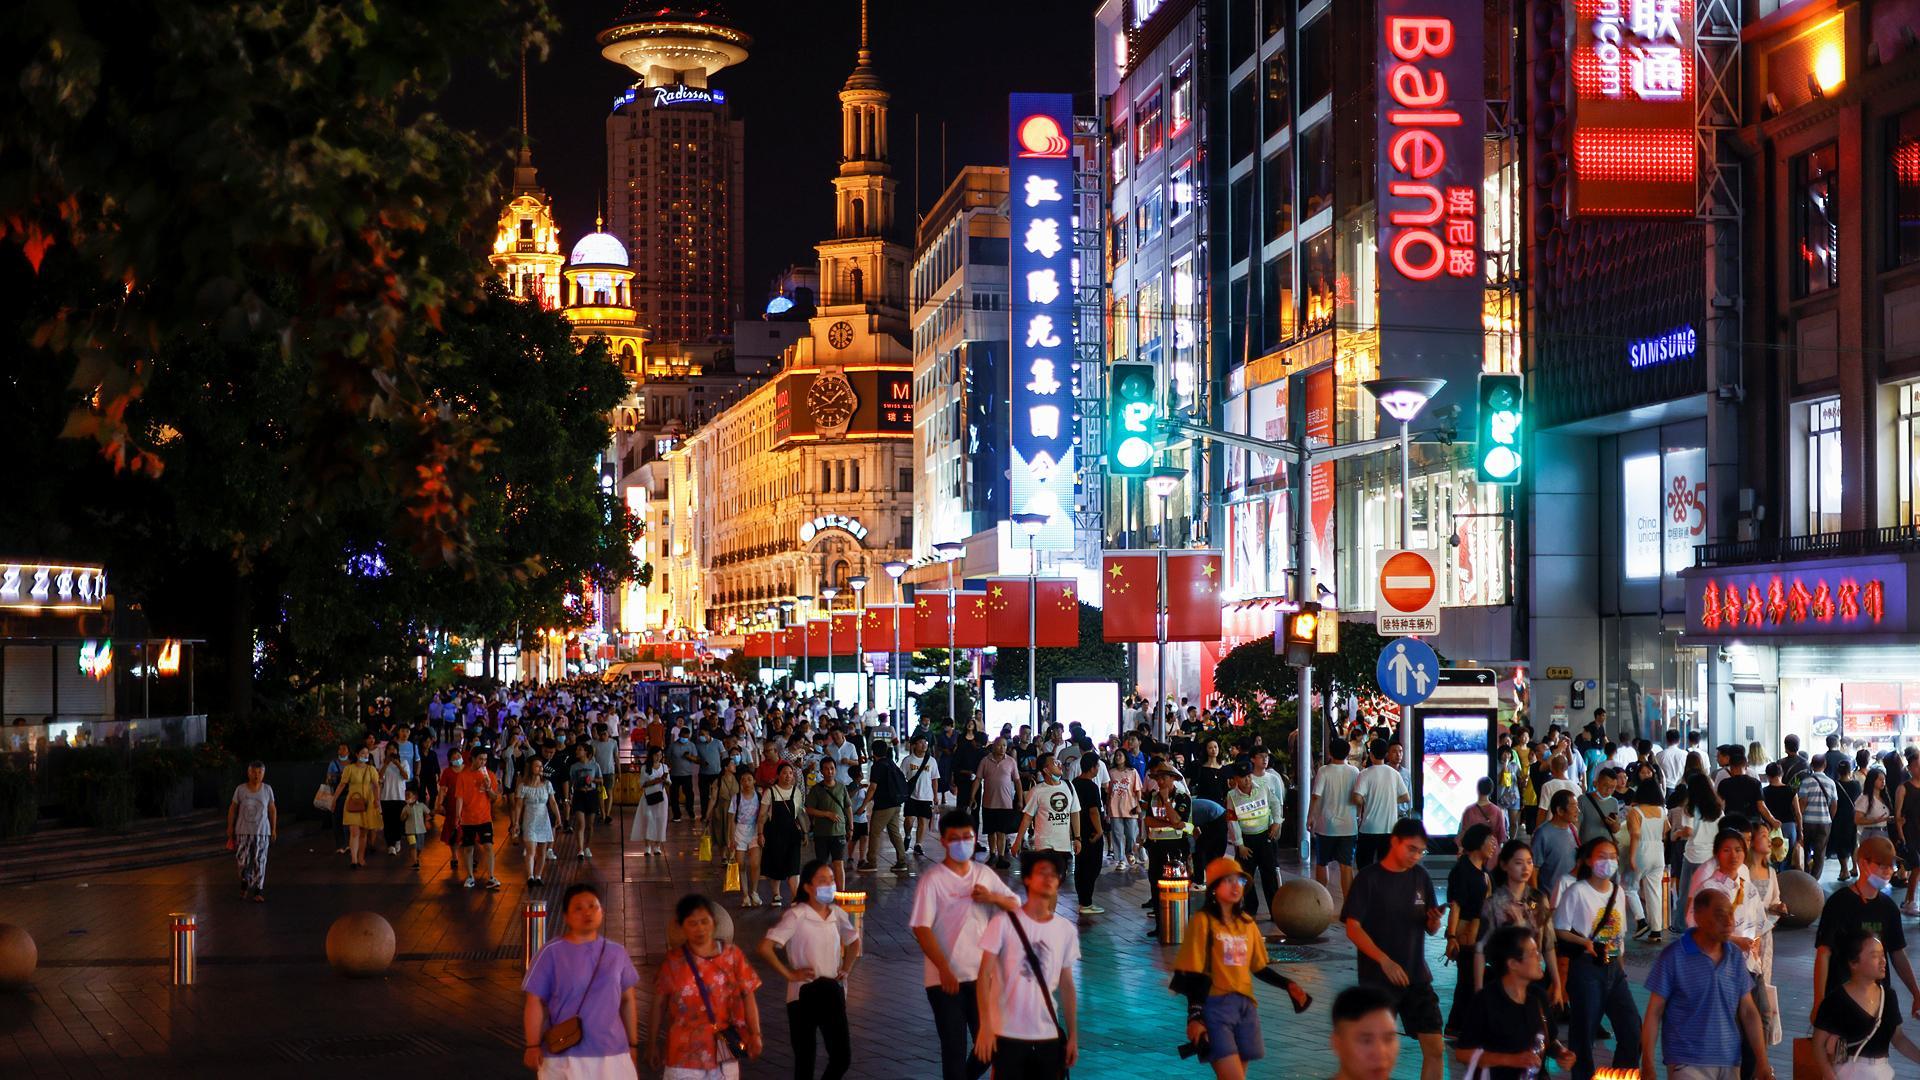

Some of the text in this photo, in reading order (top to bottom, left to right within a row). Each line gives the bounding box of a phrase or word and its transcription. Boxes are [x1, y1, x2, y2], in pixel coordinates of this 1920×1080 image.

[654, 84, 711, 107] Radisson
[1386, 16, 1462, 281] Baleno
[1448, 187, 1475, 276] 班尼路
[1631, 329, 1696, 367] SAMSUNG
[1638, 515, 1657, 529] China
[1382, 618, 1434, 630] 除特种车辆外
